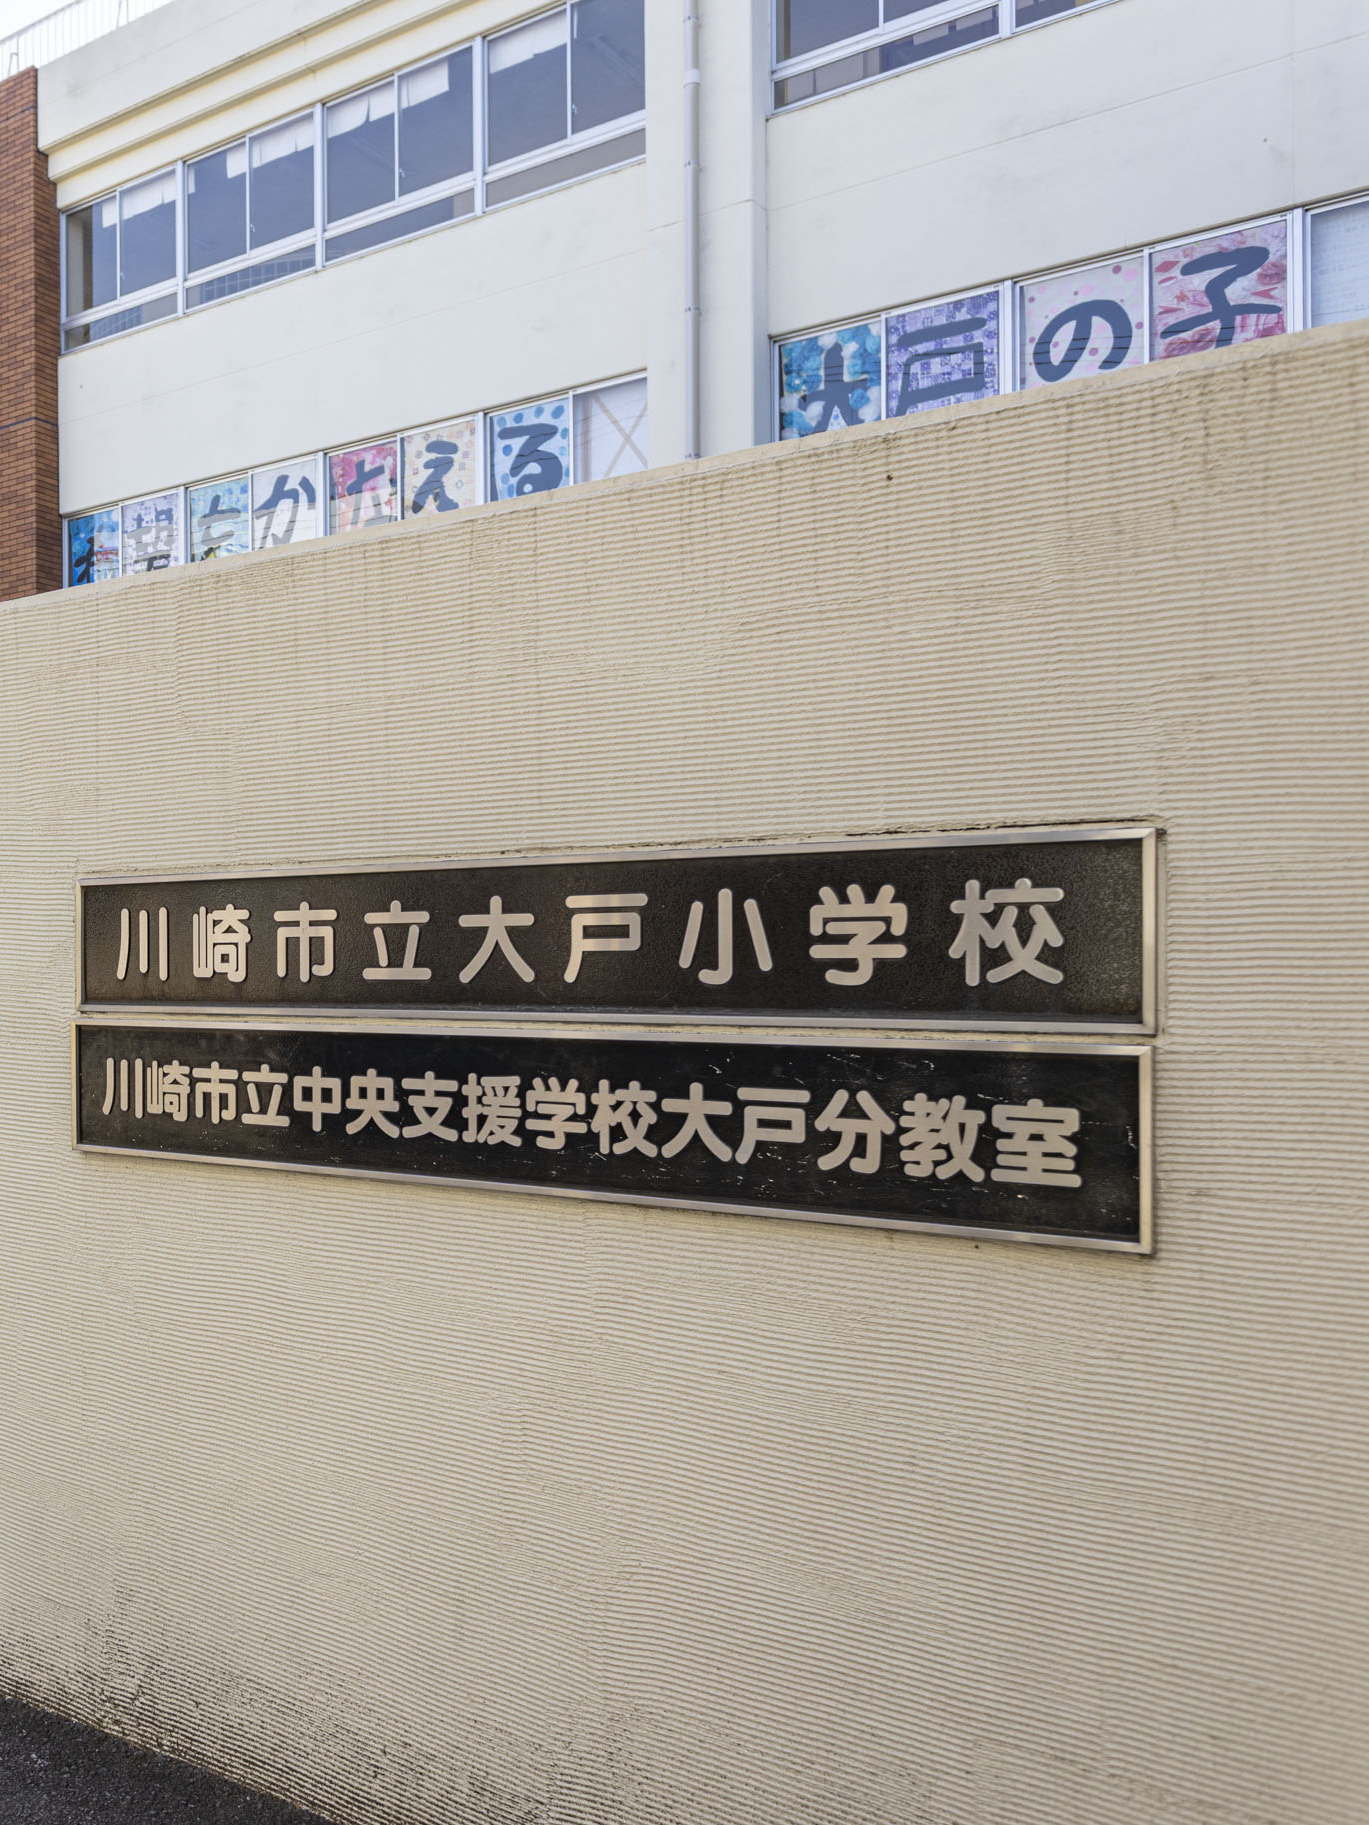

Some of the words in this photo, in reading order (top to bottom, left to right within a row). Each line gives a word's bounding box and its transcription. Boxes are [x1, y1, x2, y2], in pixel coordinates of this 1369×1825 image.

[797, 245, 1283, 432] 大戸の子
[116, 878, 1064, 987] 川崎市立大戸小学校
[102, 1056, 1082, 1188] 川崎市立中央支援学校大戸分教室
